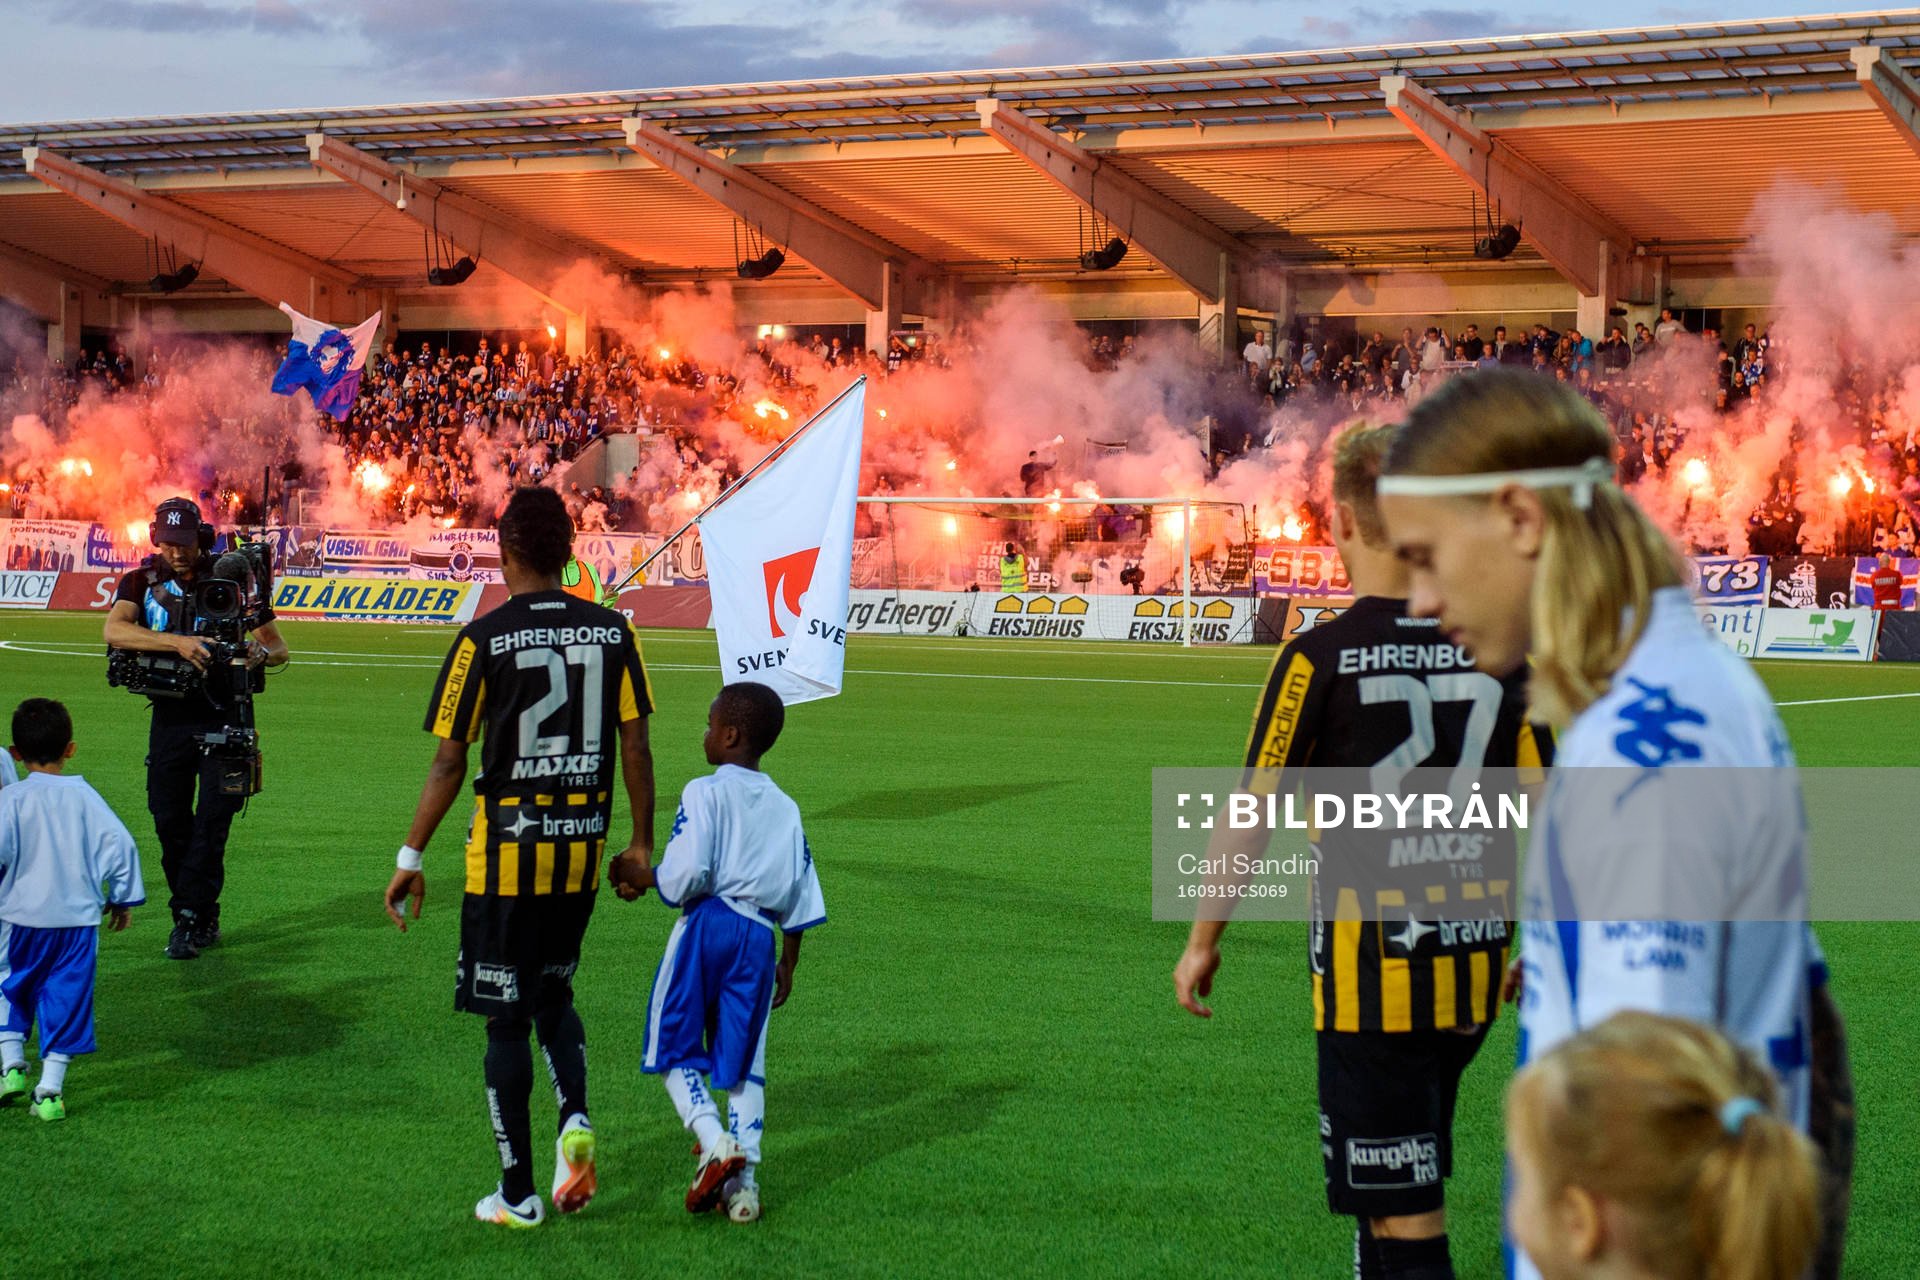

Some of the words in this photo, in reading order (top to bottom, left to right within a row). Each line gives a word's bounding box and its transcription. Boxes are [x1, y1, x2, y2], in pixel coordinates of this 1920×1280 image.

[1703, 560, 1761, 593] 73
[90, 577, 121, 607] S
[274, 580, 460, 611] BLÅKLÄDER
[847, 602, 875, 630] rg
[875, 597, 957, 633] Energi
[988, 616, 1085, 637] EKSJÖHUS
[490, 626, 623, 655] EHRENBORG
[807, 618, 846, 648] SVE
[441, 649, 472, 723] stadium
[1358, 671, 1504, 831] 27
[511, 753, 602, 780] MAXXIS
[560, 775, 599, 787] TYRES
